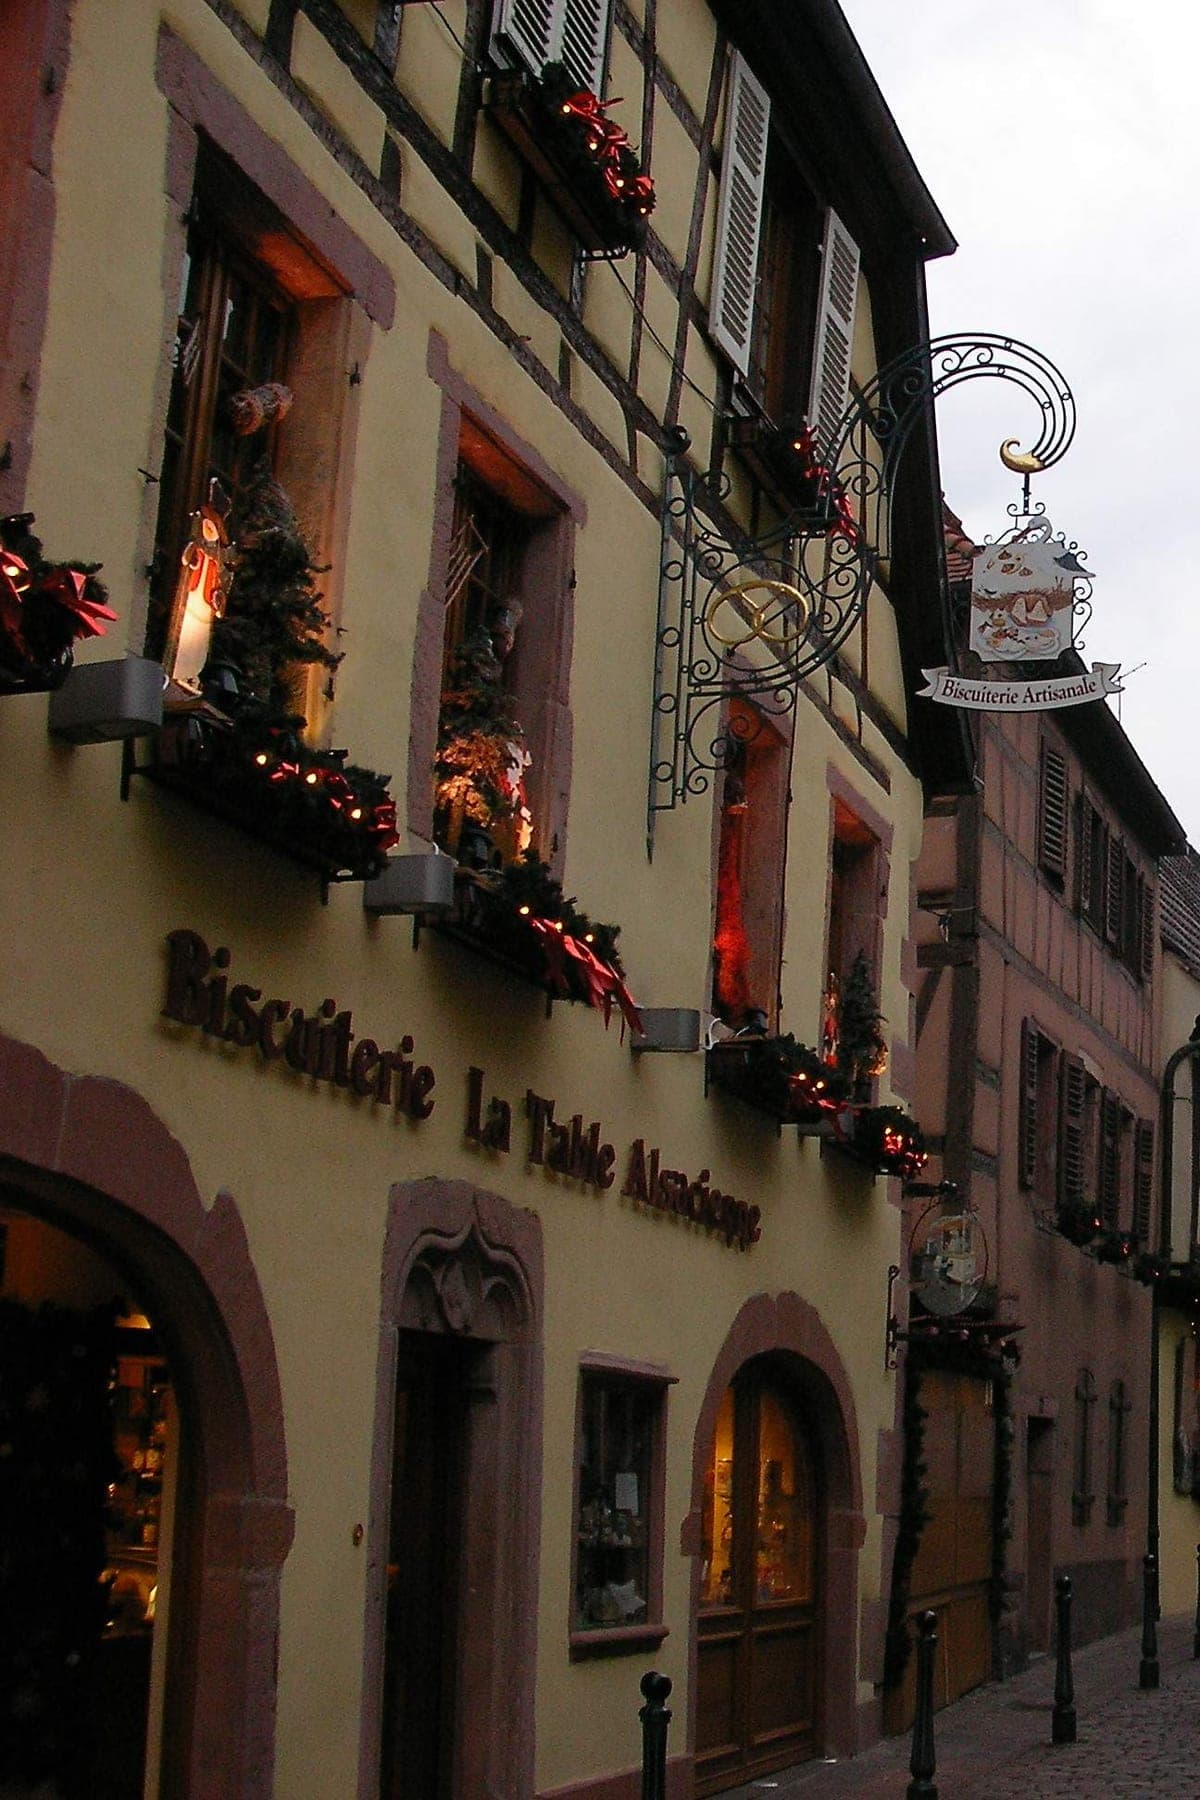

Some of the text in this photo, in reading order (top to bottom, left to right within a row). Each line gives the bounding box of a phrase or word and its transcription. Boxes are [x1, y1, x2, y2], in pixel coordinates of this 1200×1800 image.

[941, 676, 1097, 705] Biscuiterie Artisanale
[160, 929, 762, 1247] Biscuiterie La Table Alsacienne
